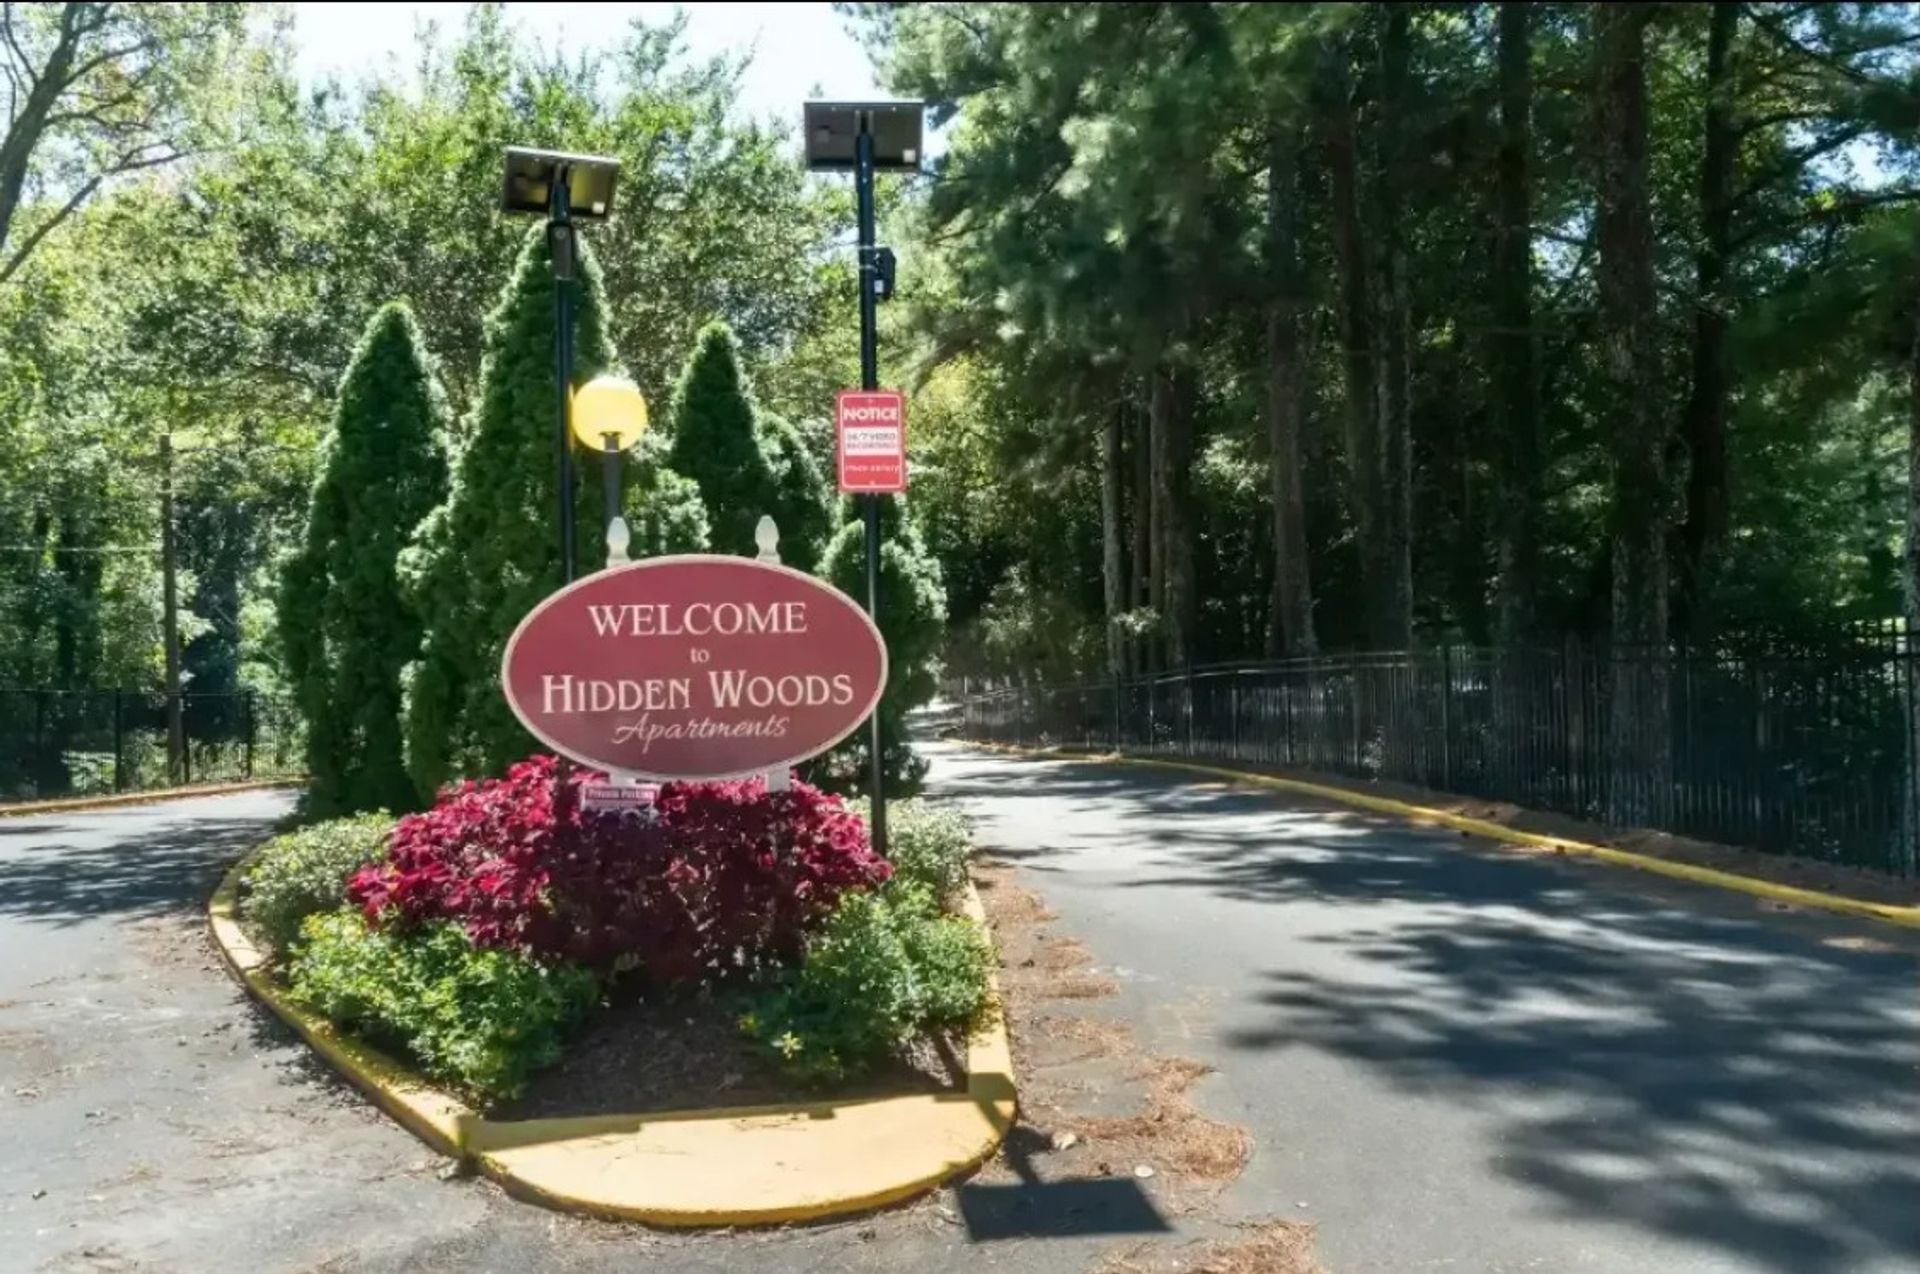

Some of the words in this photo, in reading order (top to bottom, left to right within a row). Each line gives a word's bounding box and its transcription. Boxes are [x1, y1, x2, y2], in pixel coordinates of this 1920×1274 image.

[843, 407, 898, 420] NOTICE
[588, 602, 808, 636] WELCOME
[690, 647, 710, 663] to
[541, 674, 691, 713] HIDDEN
[708, 670, 854, 709] WOODS
[612, 713, 790, 754] Apartments
